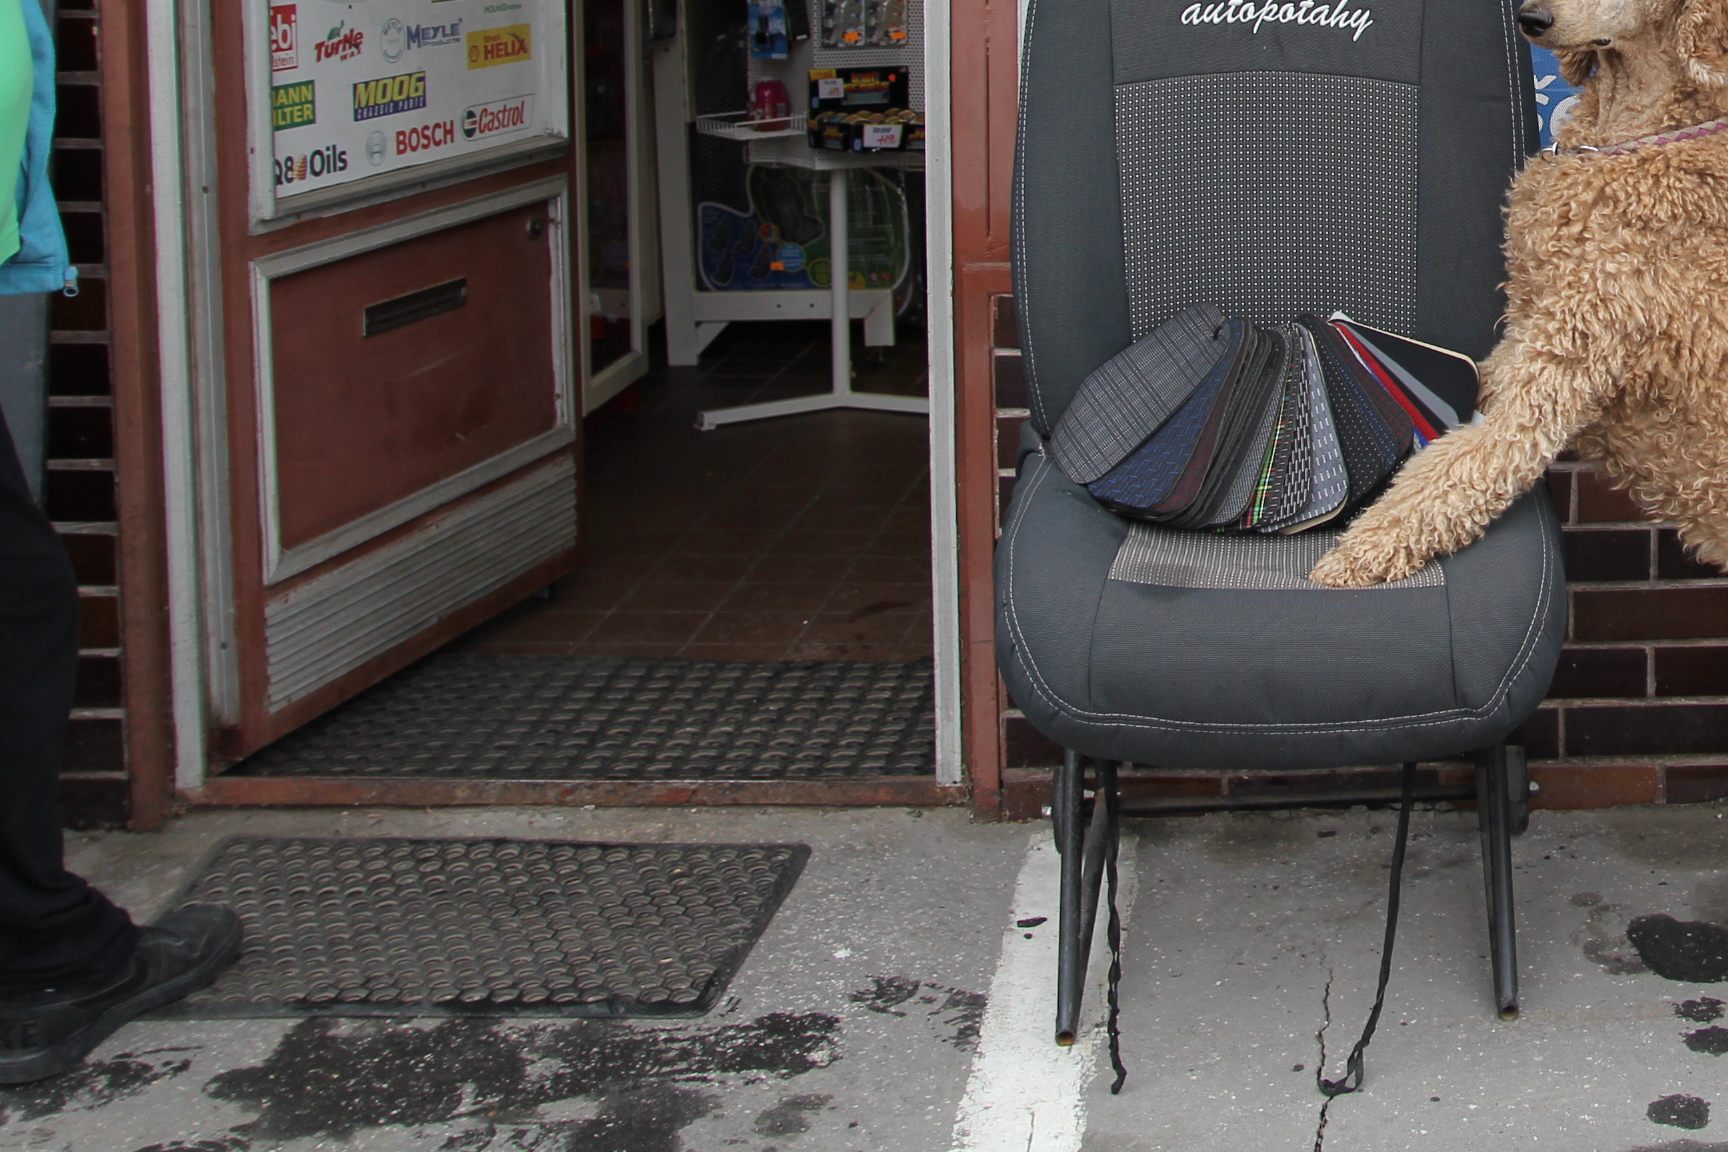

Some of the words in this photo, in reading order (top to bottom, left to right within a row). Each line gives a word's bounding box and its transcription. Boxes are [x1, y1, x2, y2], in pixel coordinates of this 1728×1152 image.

[270, 13, 297, 51] ebi
[314, 28, 364, 63] Turtle
[484, 38, 528, 62] HELIX
[272, 84, 314, 108] ANN
[354, 72, 425, 109] MOOG
[273, 104, 314, 127] ILTER
[357, 102, 394, 120] CHASSIS
[398, 97, 424, 112] PARTS
[478, 100, 526, 135] Castrol
[395, 120, 455, 156] BOSCH
[309, 144, 348, 177] Oils
